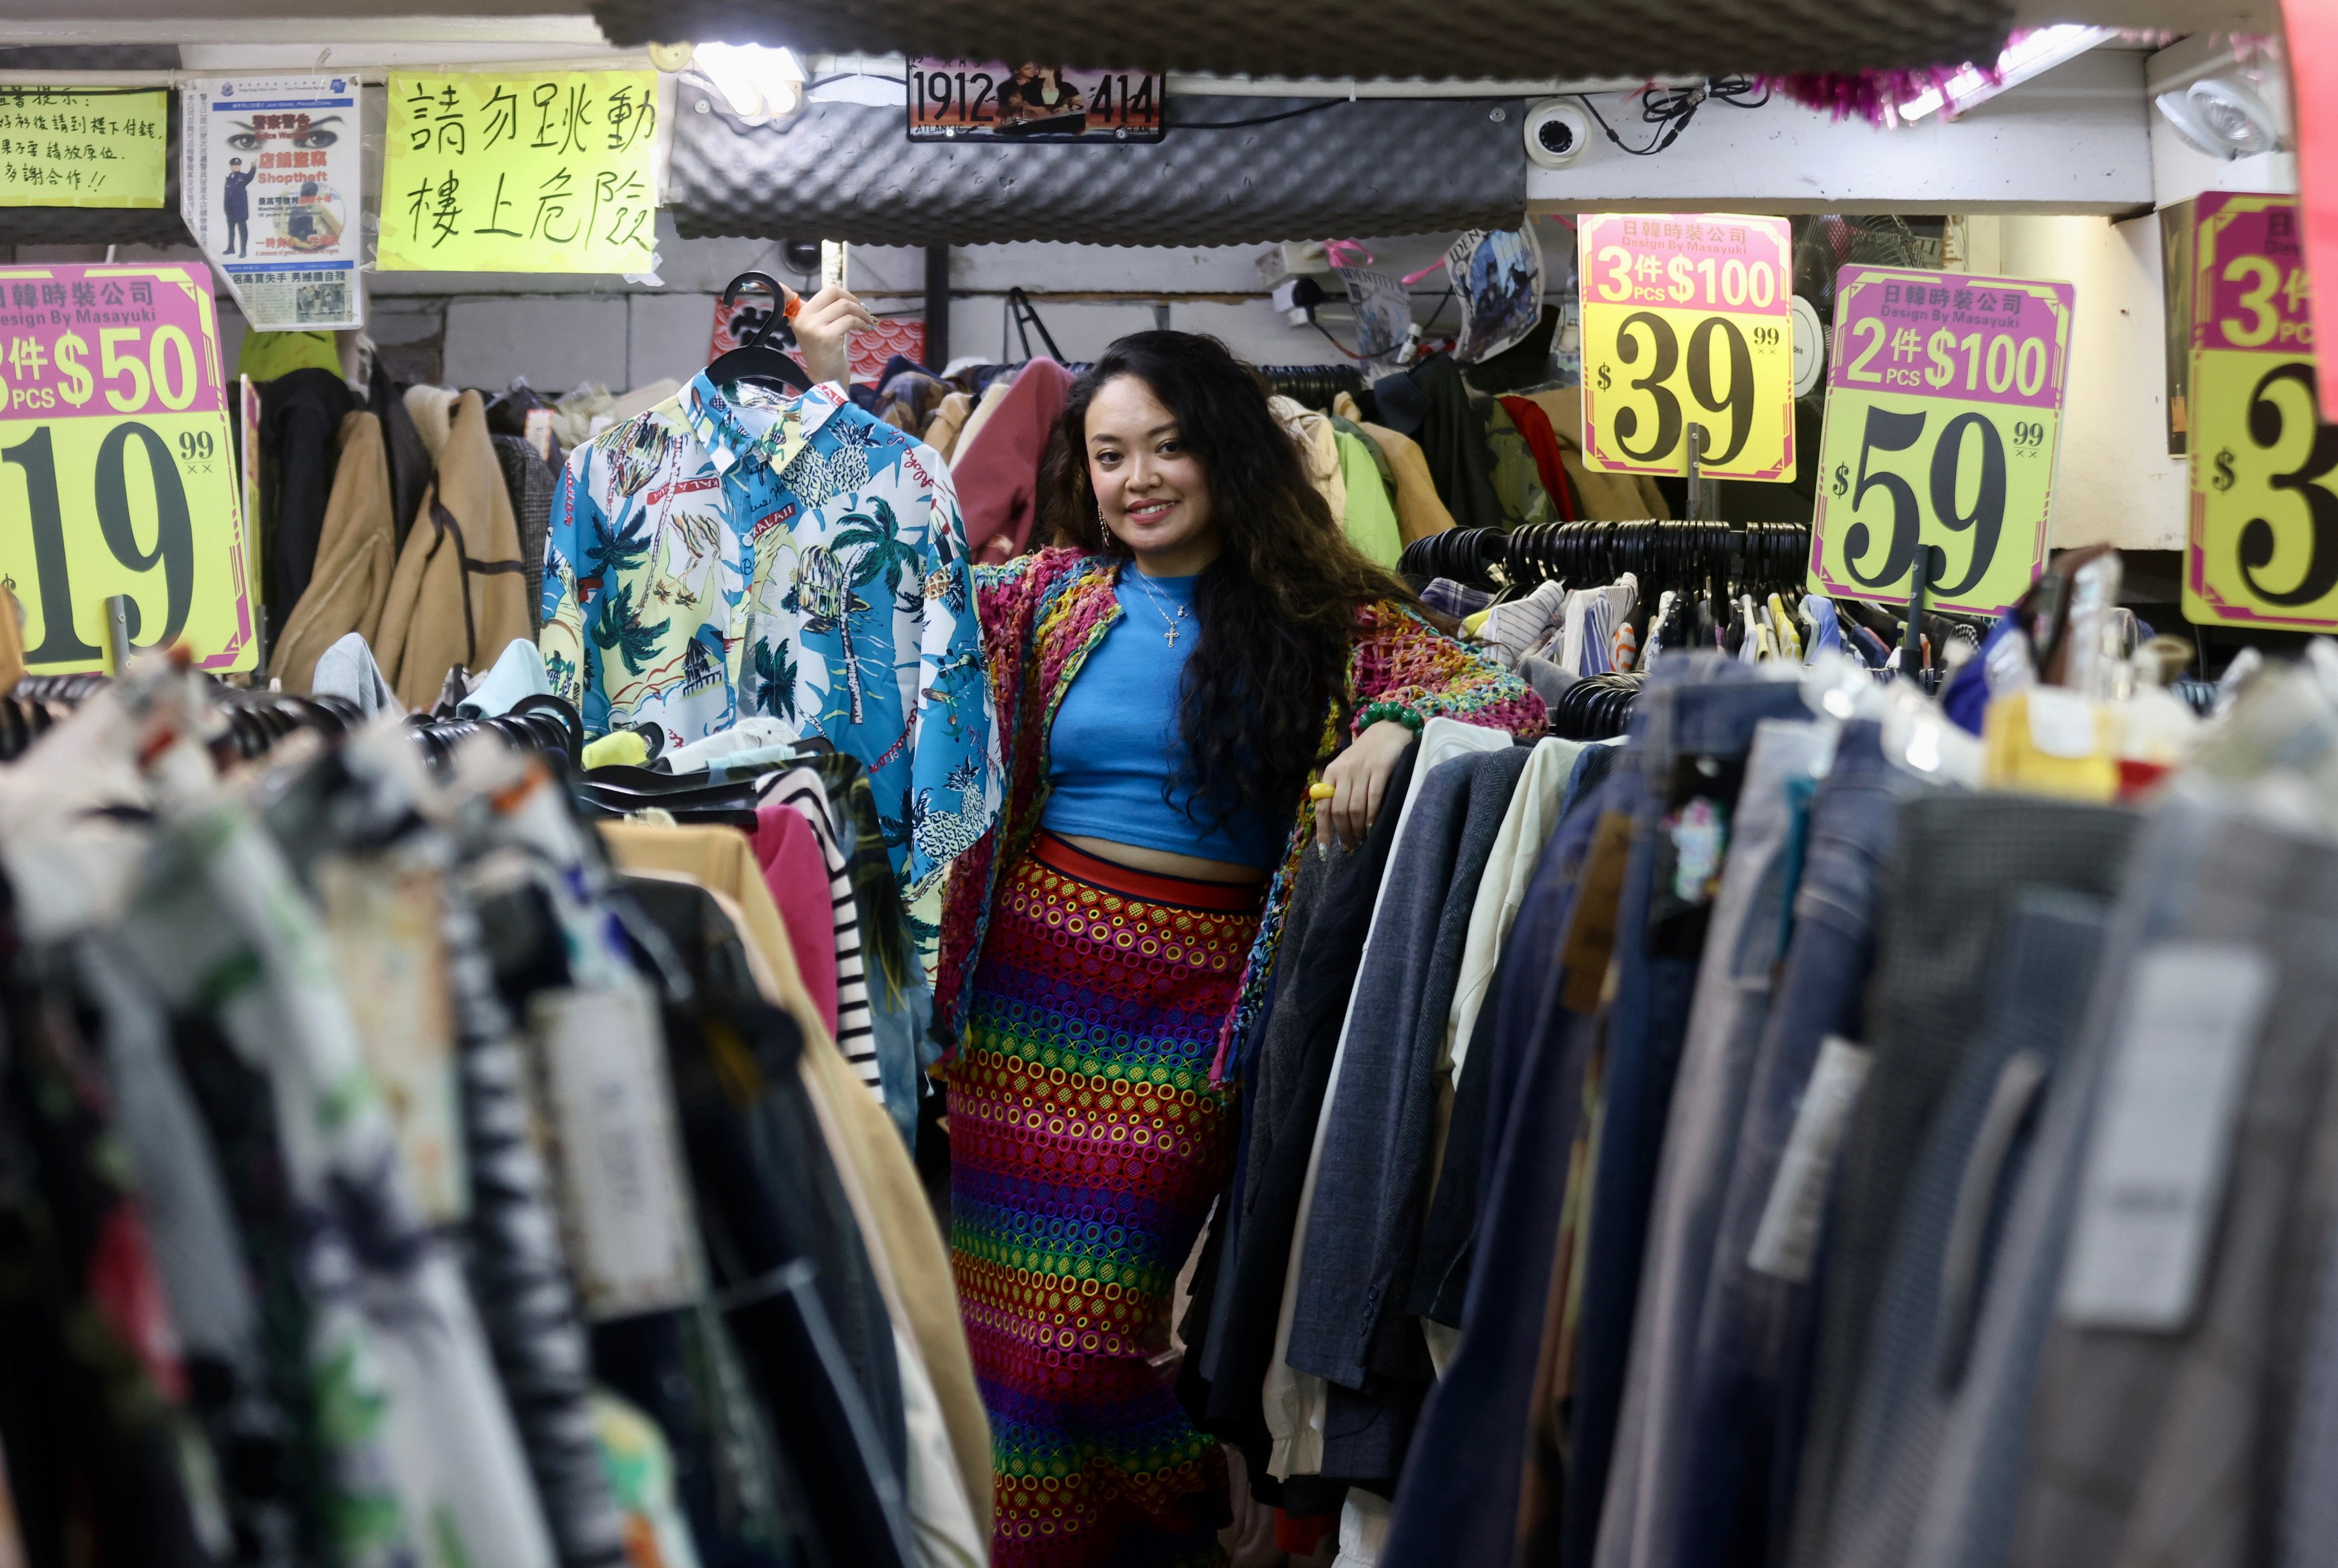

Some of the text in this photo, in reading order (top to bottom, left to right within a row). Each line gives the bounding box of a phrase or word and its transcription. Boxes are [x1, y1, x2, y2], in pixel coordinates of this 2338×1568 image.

[913, 71, 1154, 123] 1912 414
[407, 82, 655, 155] 請勿跳動
[257, 171, 328, 186] Shoptheft
[407, 167, 654, 252] 樓上危險
[1622, 236, 1747, 256] Design By Masayuki
[1623, 220, 1746, 245] 日韓時裝公司
[1598, 245, 1633, 302] 3
[1667, 252, 1775, 308] $100
[0, 281, 154, 309] 韓時裝公司
[1634, 286, 1666, 302] PCS
[1884, 285, 2022, 316] 日韓時裝公司
[50, 310, 71, 327] By
[75, 307, 156, 325] Masayuki
[1881, 305, 2021, 329] Design By Masayuki
[54, 324, 197, 413] $50
[1847, 317, 1886, 384] 2
[1924, 327, 2046, 397] $100
[1614, 311, 1755, 467] 39
[1754, 326, 1780, 346] 99
[1886, 368, 1921, 387] PCS
[12, 386, 56, 410] PCS
[179, 430, 214, 461] 99
[1843, 405, 2006, 598] 59
[2013, 421, 2044, 448] 99
